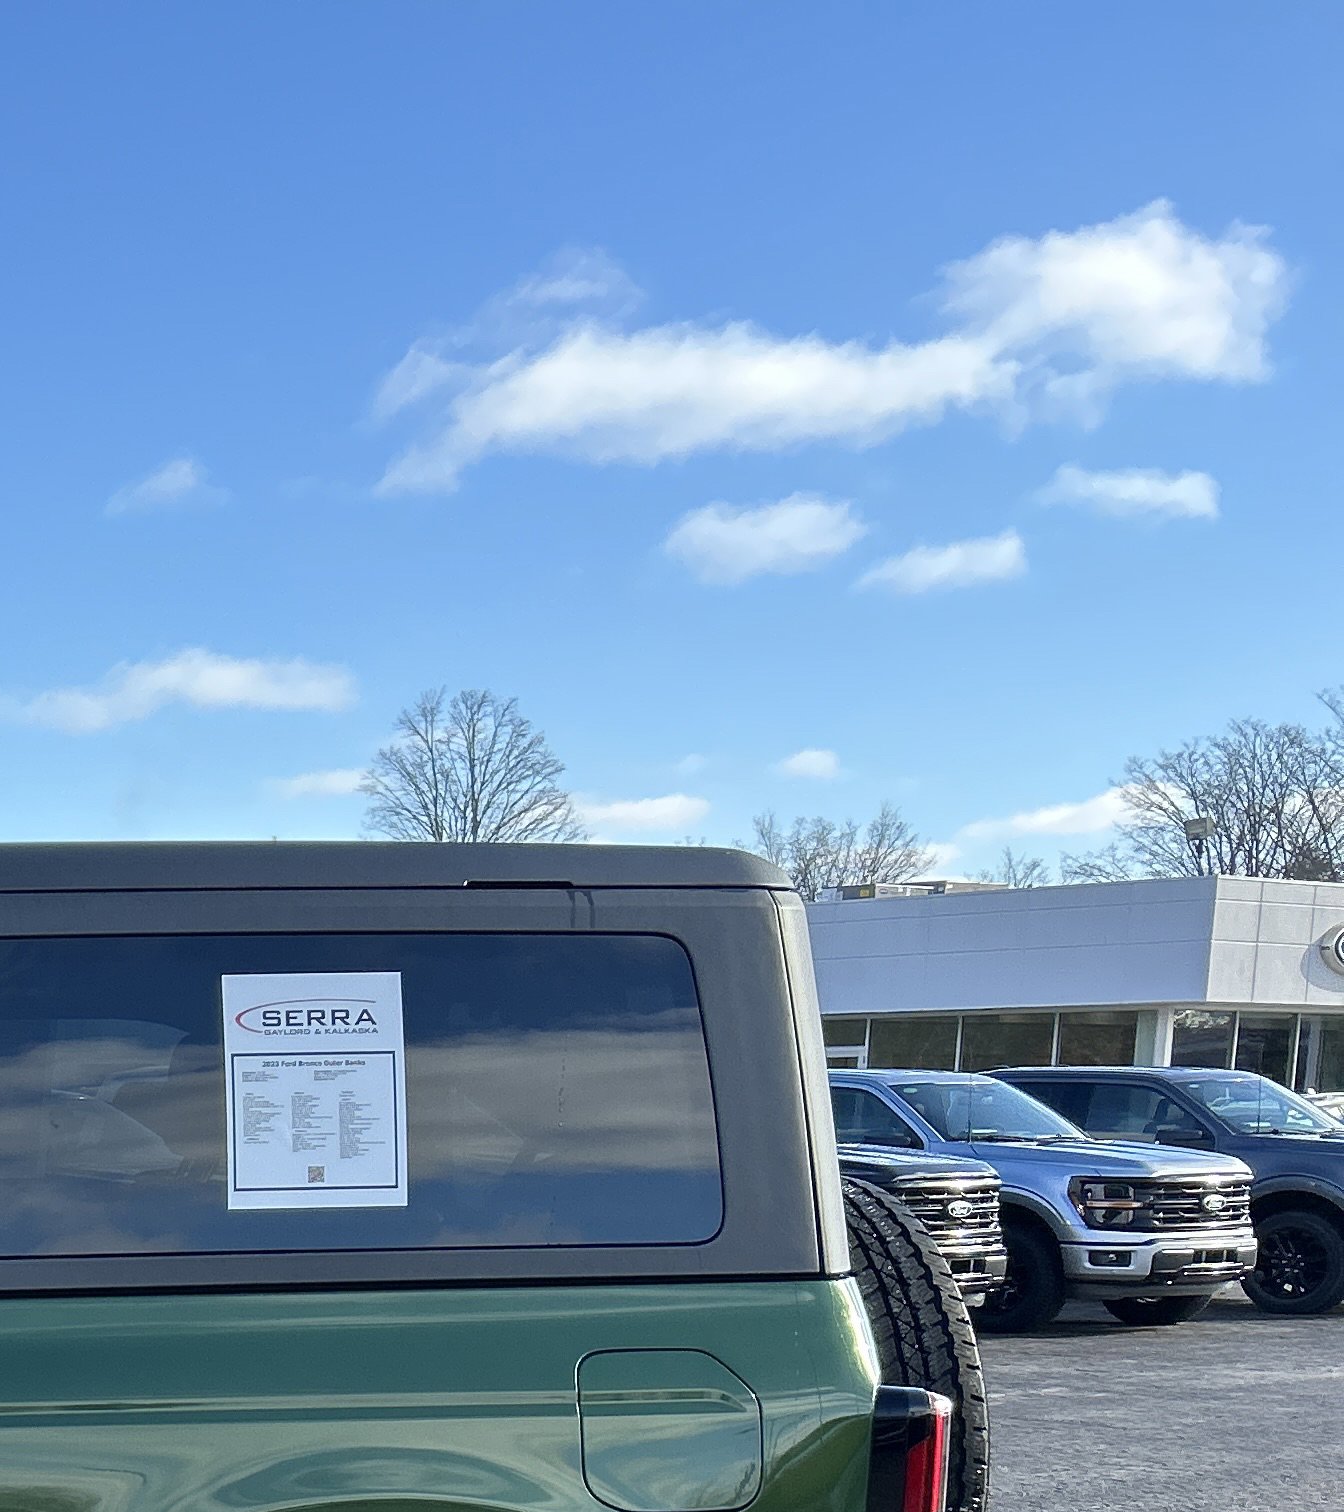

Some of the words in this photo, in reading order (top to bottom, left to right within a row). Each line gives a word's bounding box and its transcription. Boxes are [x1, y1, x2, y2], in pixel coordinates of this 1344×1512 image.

[262, 1009, 377, 1027] SERRA
[264, 1028, 311, 1036] GAYLORD
[324, 1027, 379, 1035] KALKASKA
